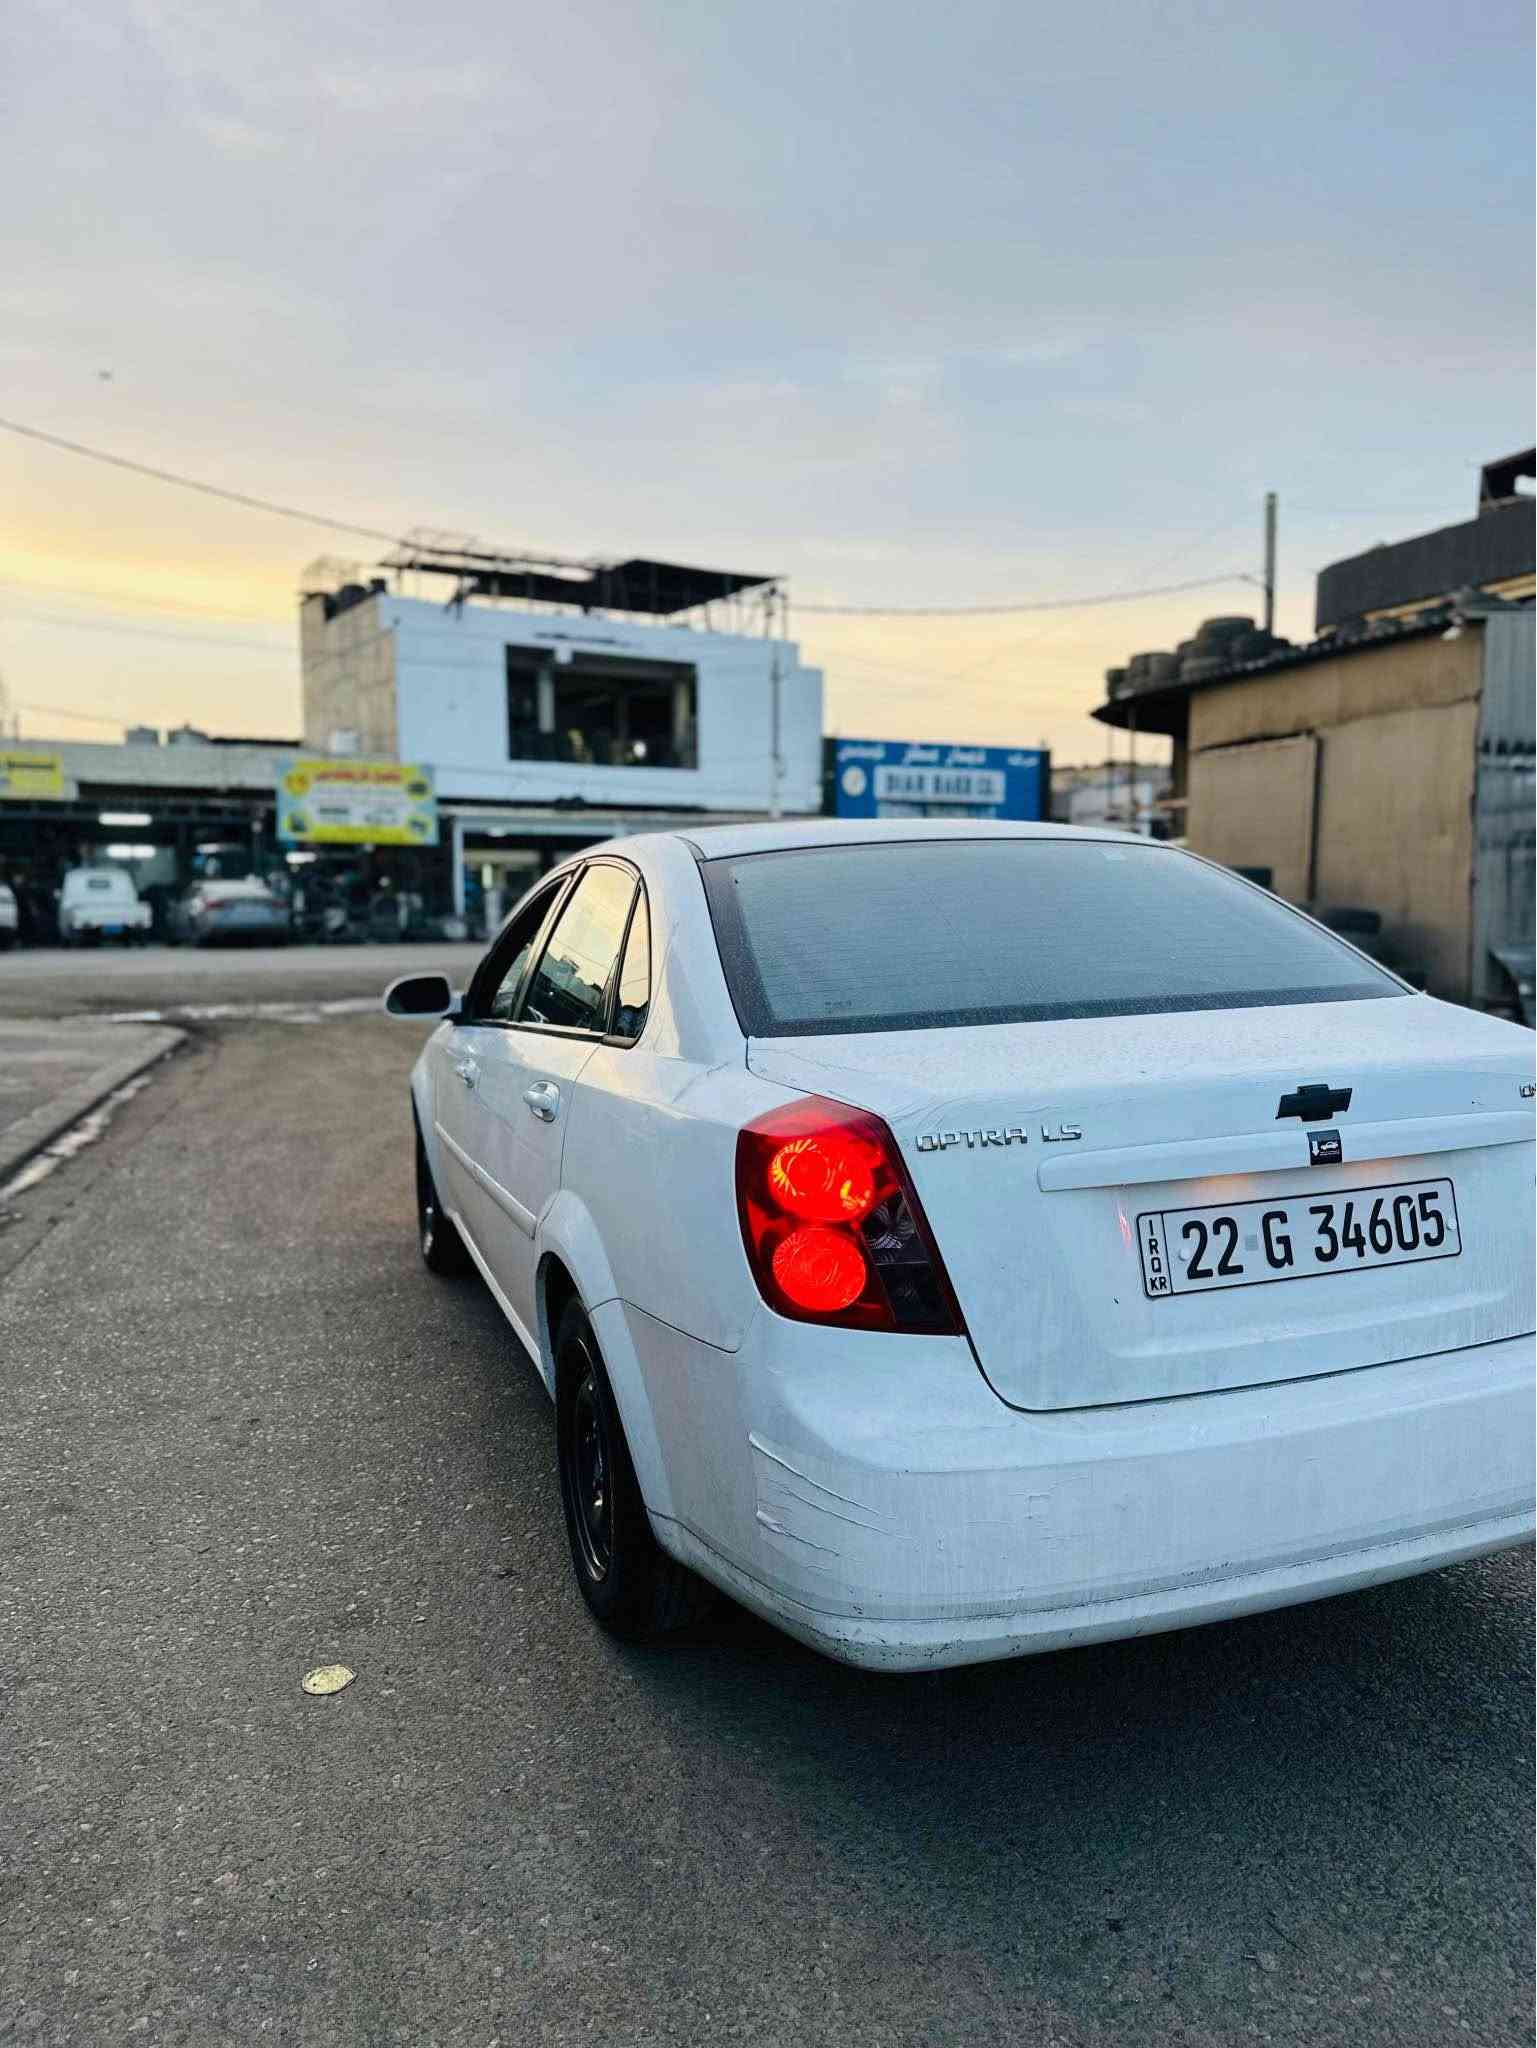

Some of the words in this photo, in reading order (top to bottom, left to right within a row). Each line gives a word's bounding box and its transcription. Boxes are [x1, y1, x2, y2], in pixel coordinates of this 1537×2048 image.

[915, 1127, 1028, 1152] OPTRA
[1040, 1123, 1083, 1143] LS
[1182, 1216, 1244, 1280] 22
[1261, 1210, 1294, 1269] G
[1308, 1191, 1445, 1263] 34605
[1149, 1276, 1168, 1291] KR
